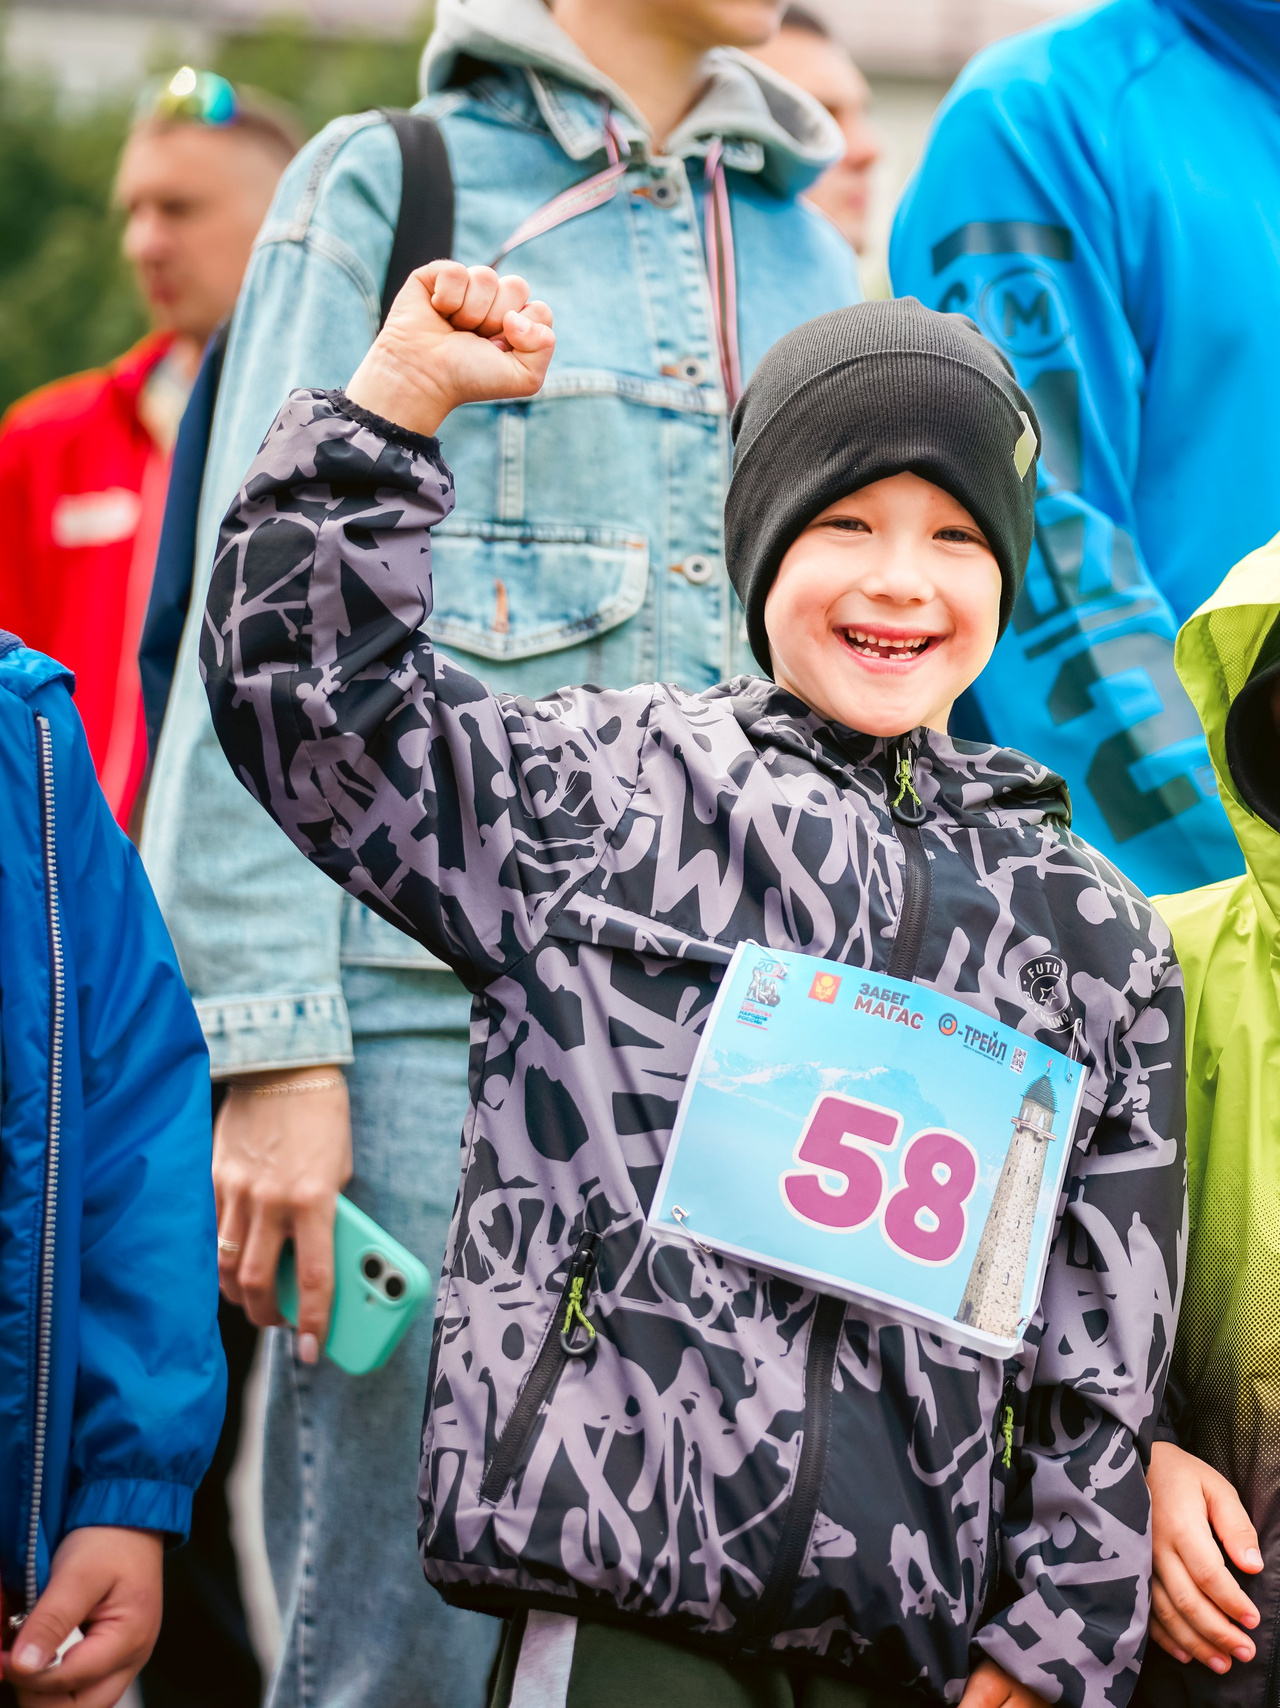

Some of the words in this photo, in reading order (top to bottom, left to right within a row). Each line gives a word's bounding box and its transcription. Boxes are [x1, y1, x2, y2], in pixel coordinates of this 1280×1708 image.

[859, 982, 910, 1006] ЗАБЕГ
[853, 995, 924, 1030] МАГАС
[781, 1093, 978, 1265] 58
